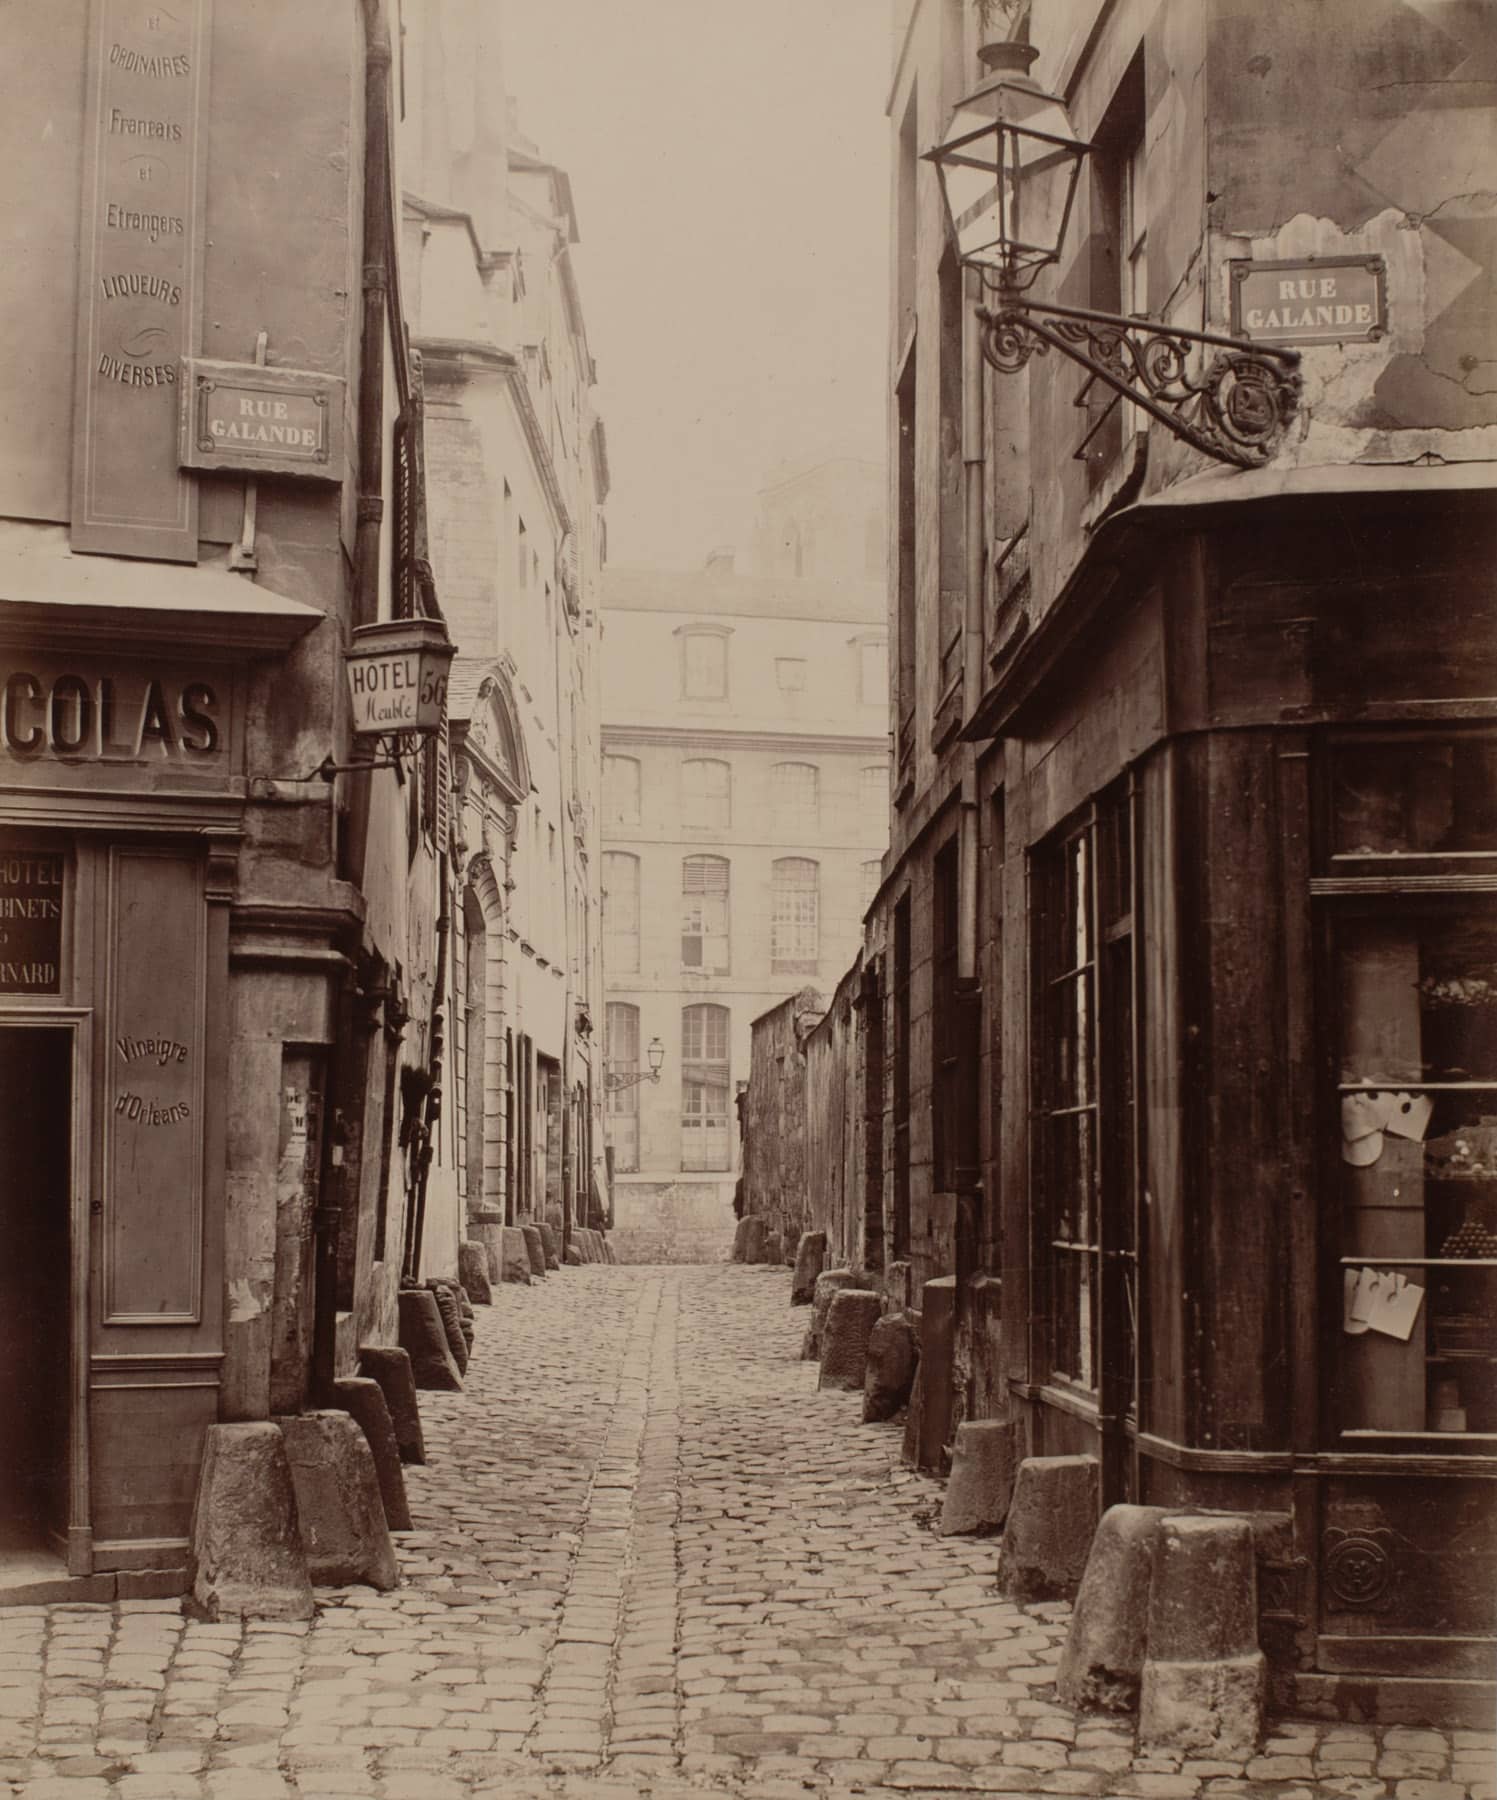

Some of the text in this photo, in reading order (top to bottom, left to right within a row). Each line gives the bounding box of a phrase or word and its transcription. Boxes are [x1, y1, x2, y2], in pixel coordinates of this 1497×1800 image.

[109, 43, 190, 78] ORDINAIRES
[138, 166, 152, 181] et
[107, 202, 184, 242] Etrangers
[102, 274, 182, 305] LIQUEURS
[1279, 278, 1337, 300] RUE
[1246, 305, 1373, 329] GALANDE
[239, 398, 288, 420] RUE
[211, 420, 316, 446] GALANDE
[2, 671, 219, 757] COLAS
[117, 1032, 188, 1066] Vinaigre
